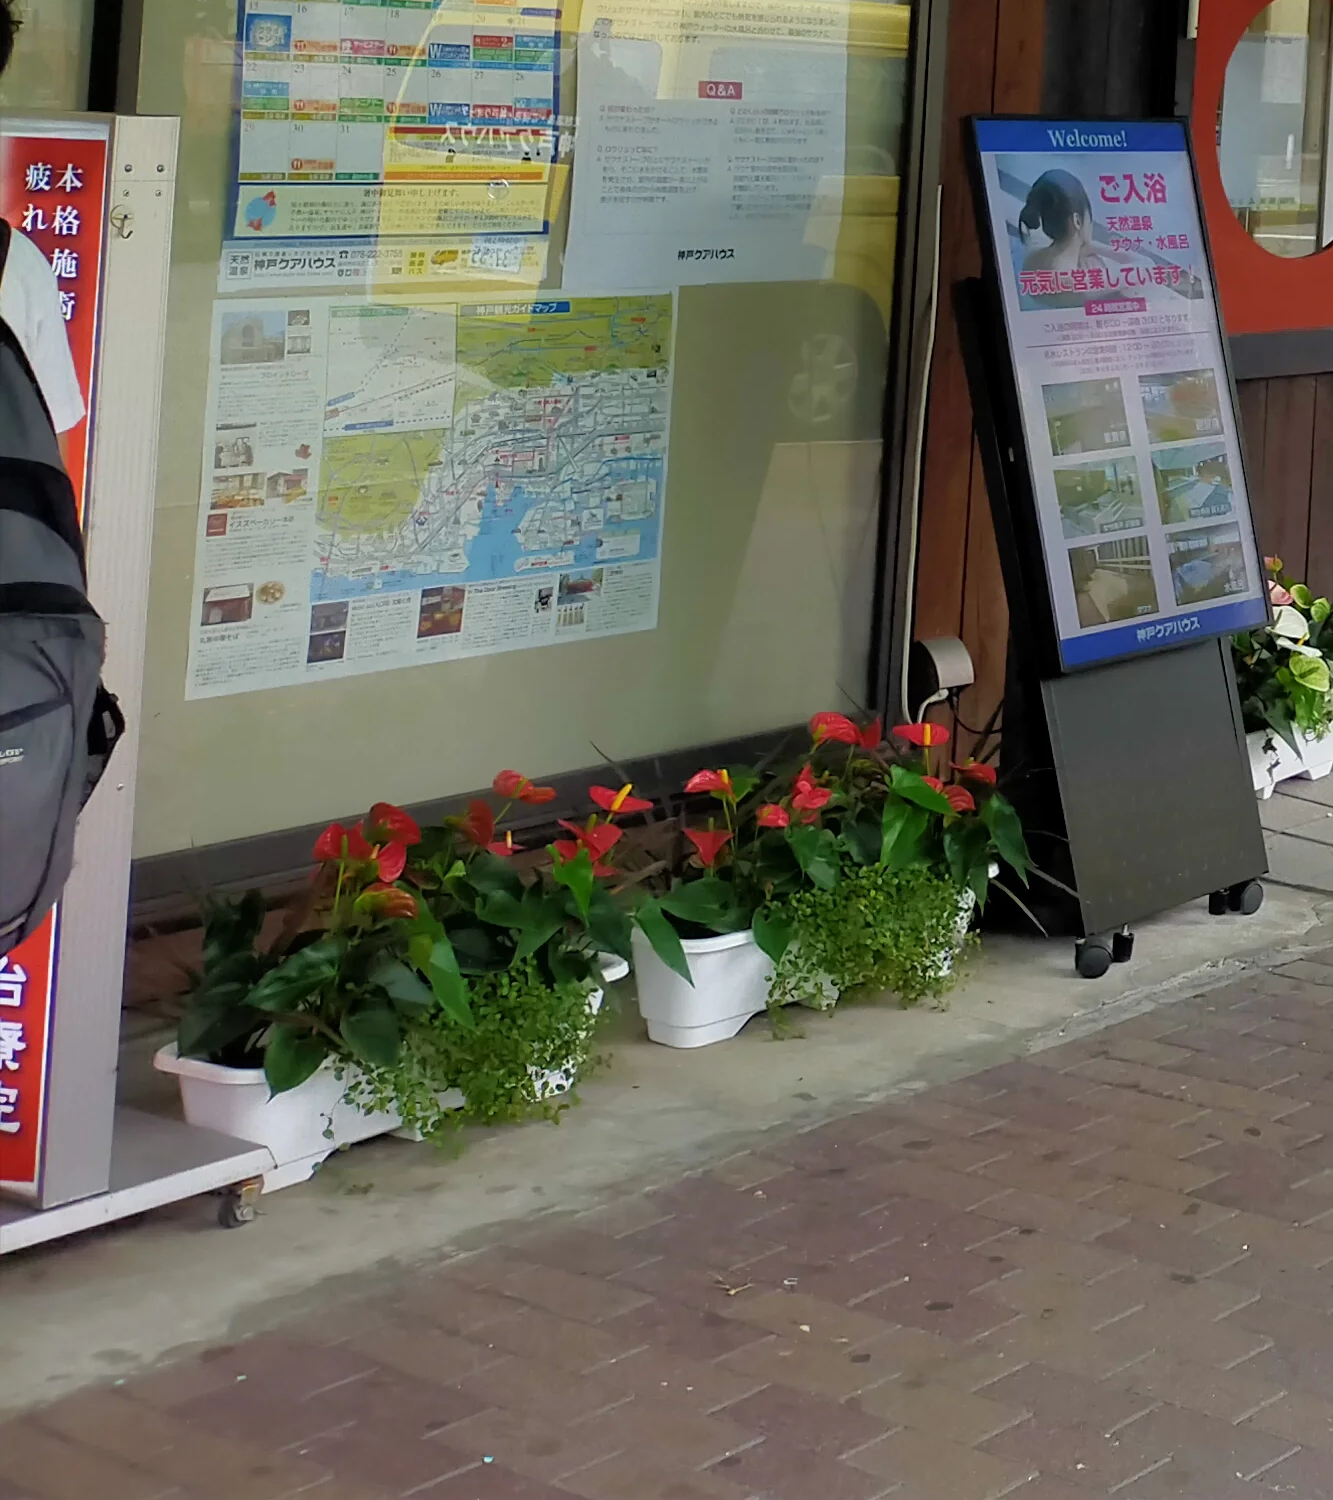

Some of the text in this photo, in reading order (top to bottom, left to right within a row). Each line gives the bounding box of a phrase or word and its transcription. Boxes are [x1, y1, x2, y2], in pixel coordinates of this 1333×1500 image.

[706, 83, 736, 97] Q&A
[1047, 128, 1128, 150] Welcome!
[1098, 173, 1167, 205] ご入浴
[1105, 216, 1153, 232] 天然温泉
[1110, 234, 1190, 252] サウナ・水風呂
[677, 248, 735, 261] 神戸クアハウス
[254, 257, 336, 270] 神戸クアハウス
[475, 302, 557, 316] 神戸観光ガイドマップ
[1136, 616, 1201, 643] 神戸クアハウス
